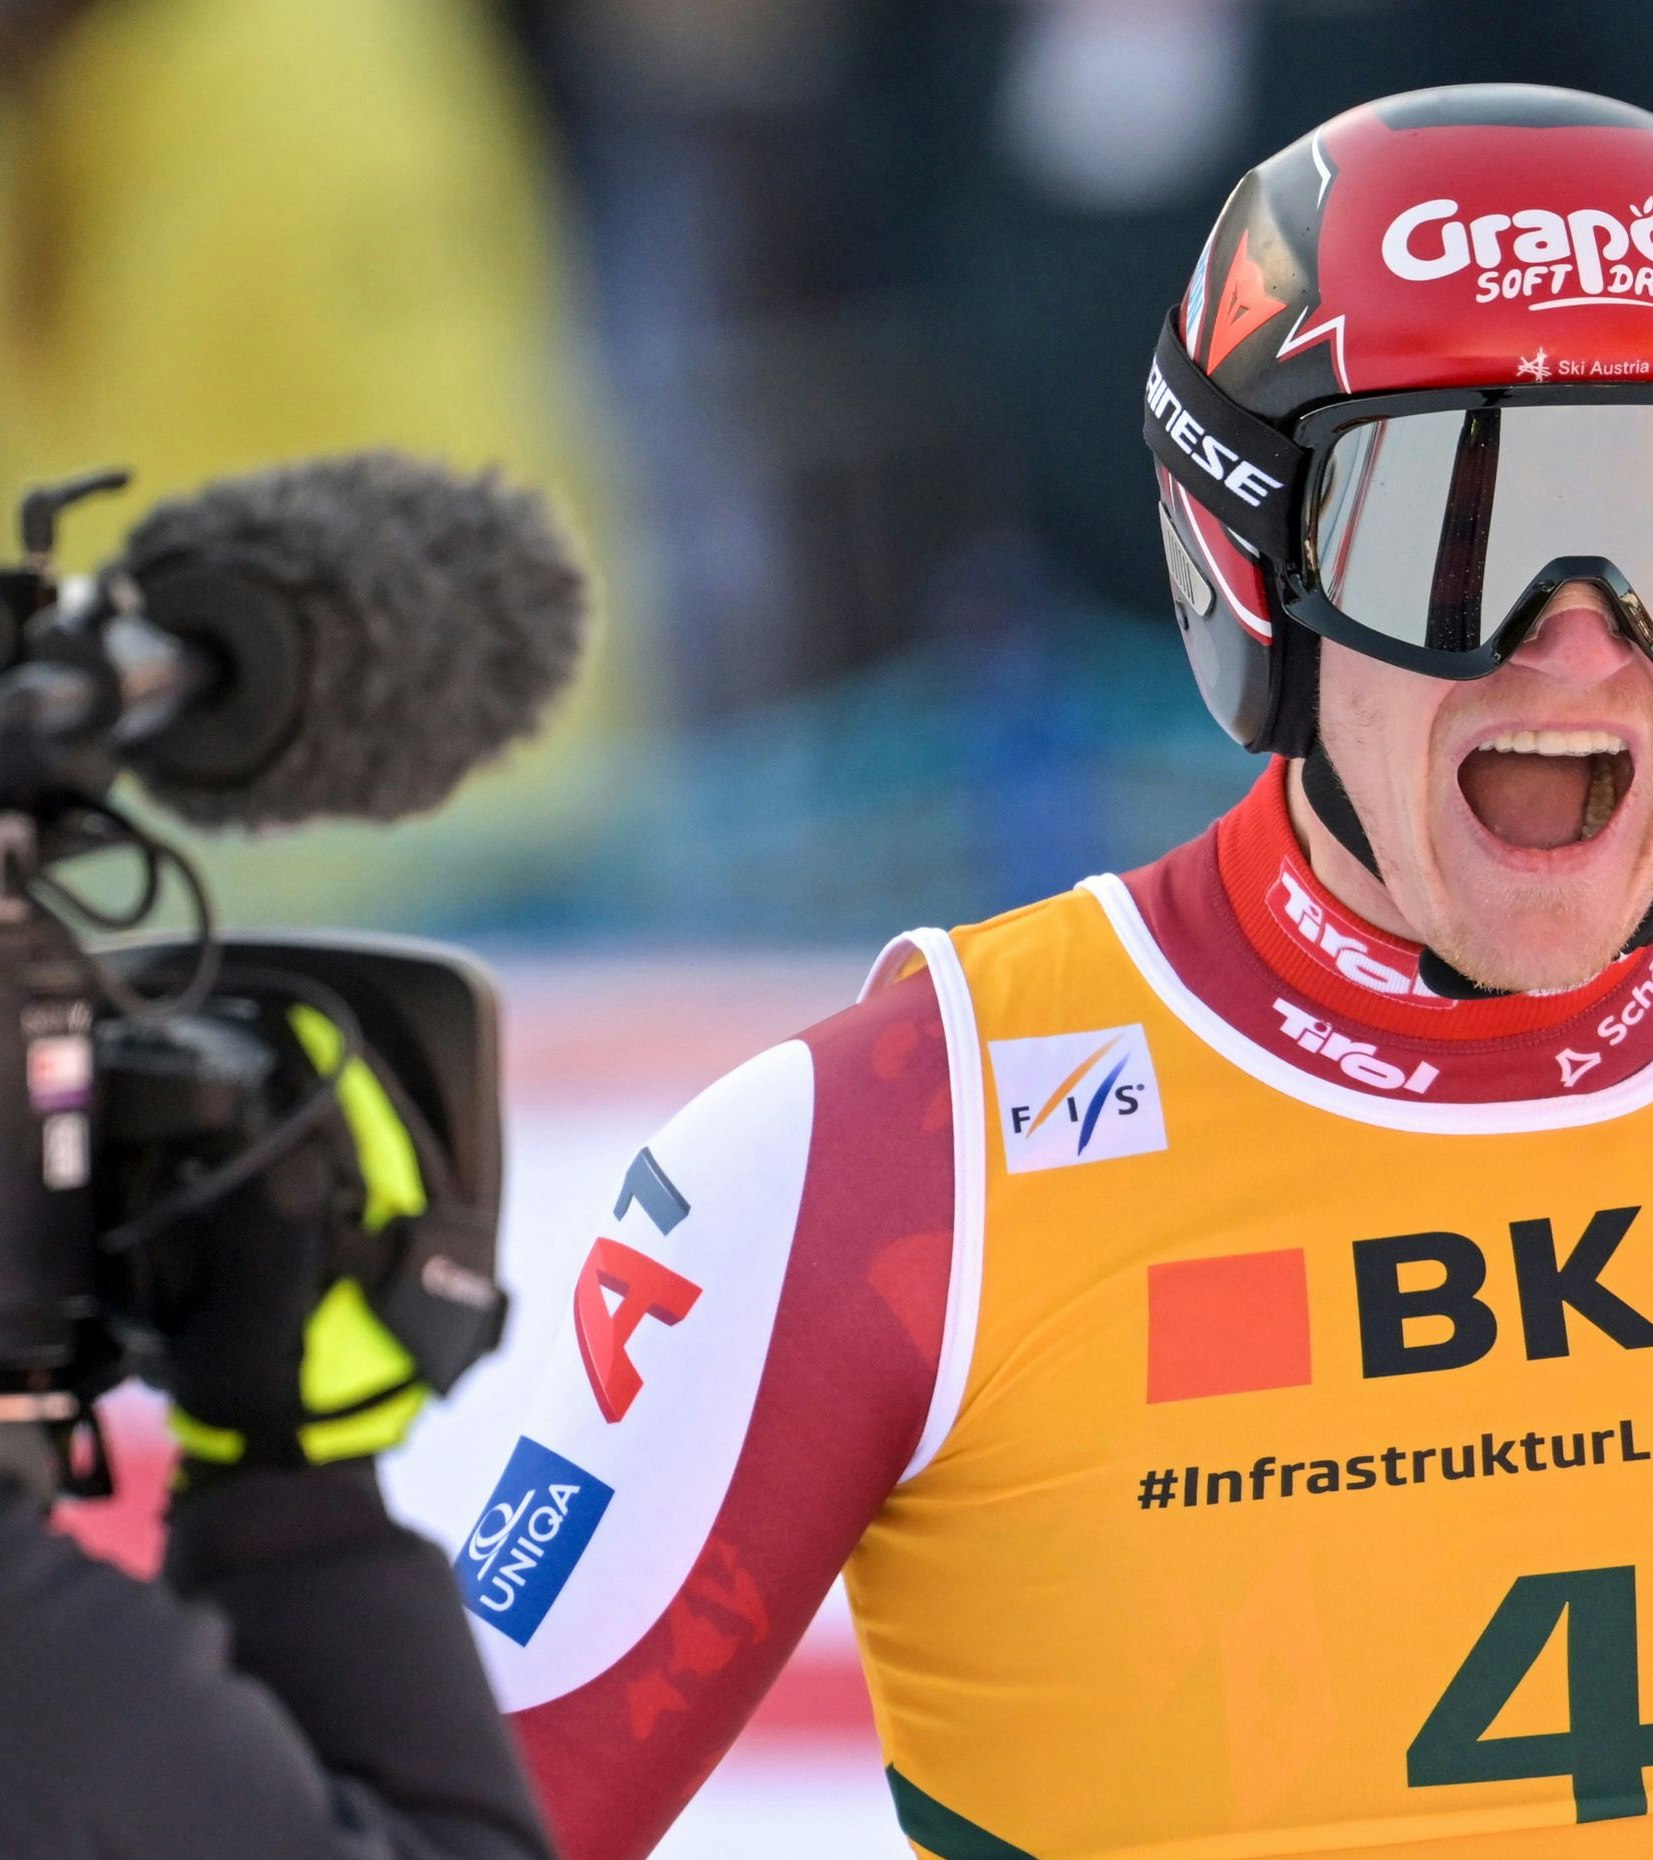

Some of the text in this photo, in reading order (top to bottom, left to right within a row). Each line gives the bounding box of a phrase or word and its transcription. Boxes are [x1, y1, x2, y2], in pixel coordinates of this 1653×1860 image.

[1476, 263, 1572, 304] SOFT
[1558, 359, 1650, 376] Ski Austria
[1146, 353, 1284, 507] AINESE
[1271, 996, 1440, 1094] Tirol
[1011, 1084, 1144, 1134] FIS
[480, 1484, 581, 1612] UNIQA
